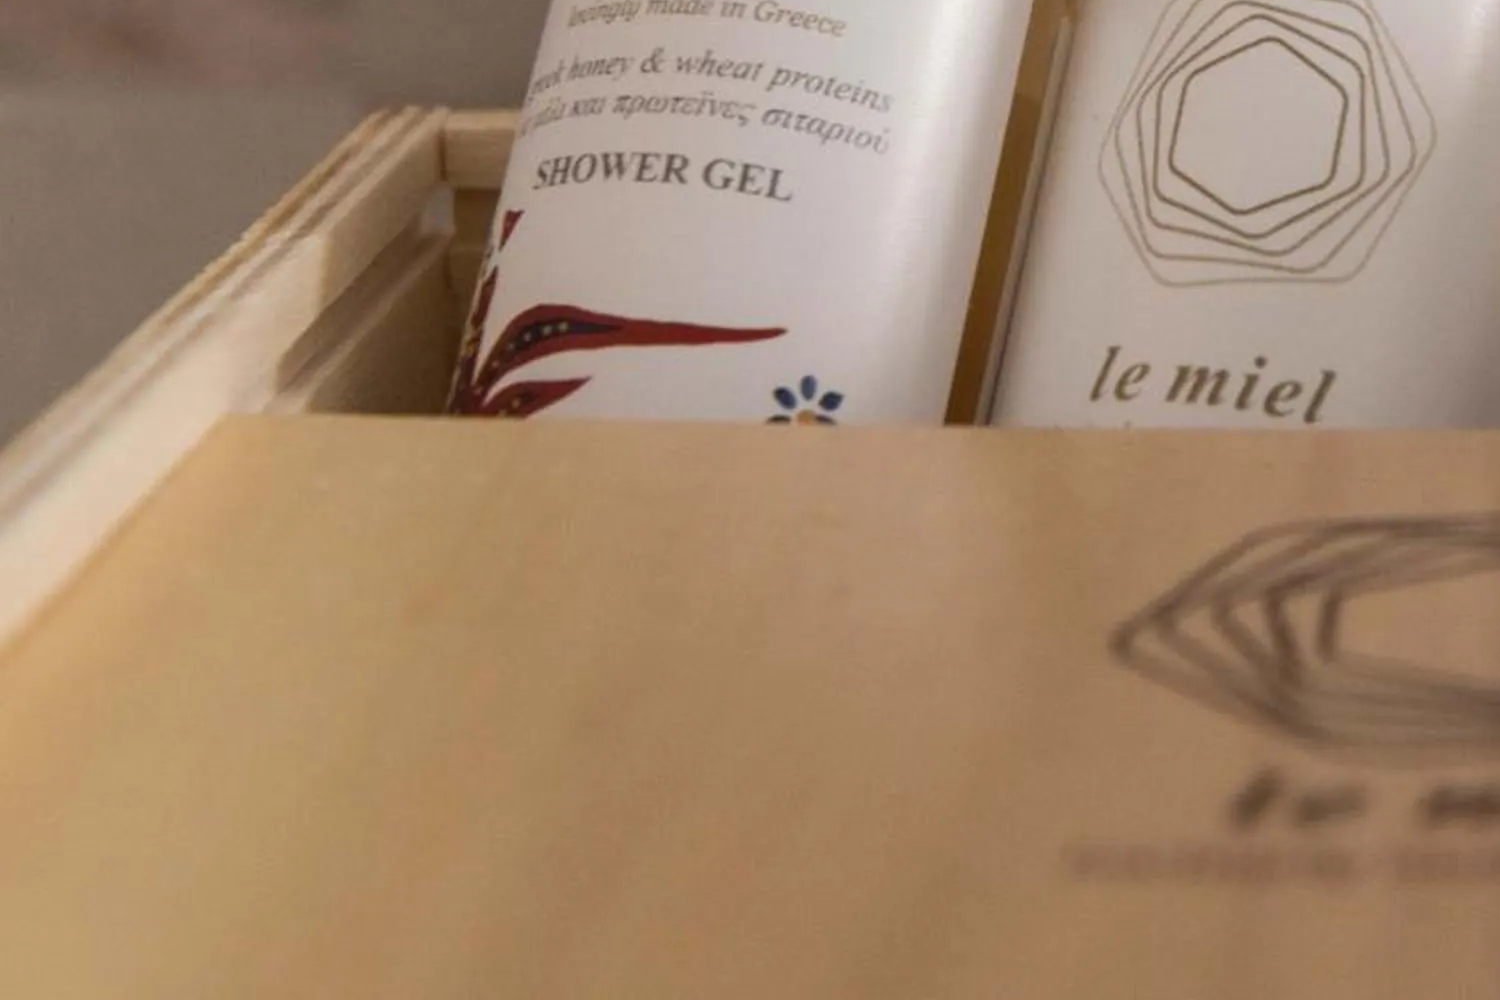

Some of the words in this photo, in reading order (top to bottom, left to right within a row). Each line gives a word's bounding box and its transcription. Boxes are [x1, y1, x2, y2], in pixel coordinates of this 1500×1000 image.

[753, 0, 847, 37] Greece
[640, 47, 665, 74] &
[676, 49, 764, 82] wheat
[765, 66, 896, 113] proteins
[532, 151, 689, 191] SHOWER
[702, 158, 793, 202] GEL
[1089, 345, 1152, 402] le
[1164, 355, 1338, 425] miel
